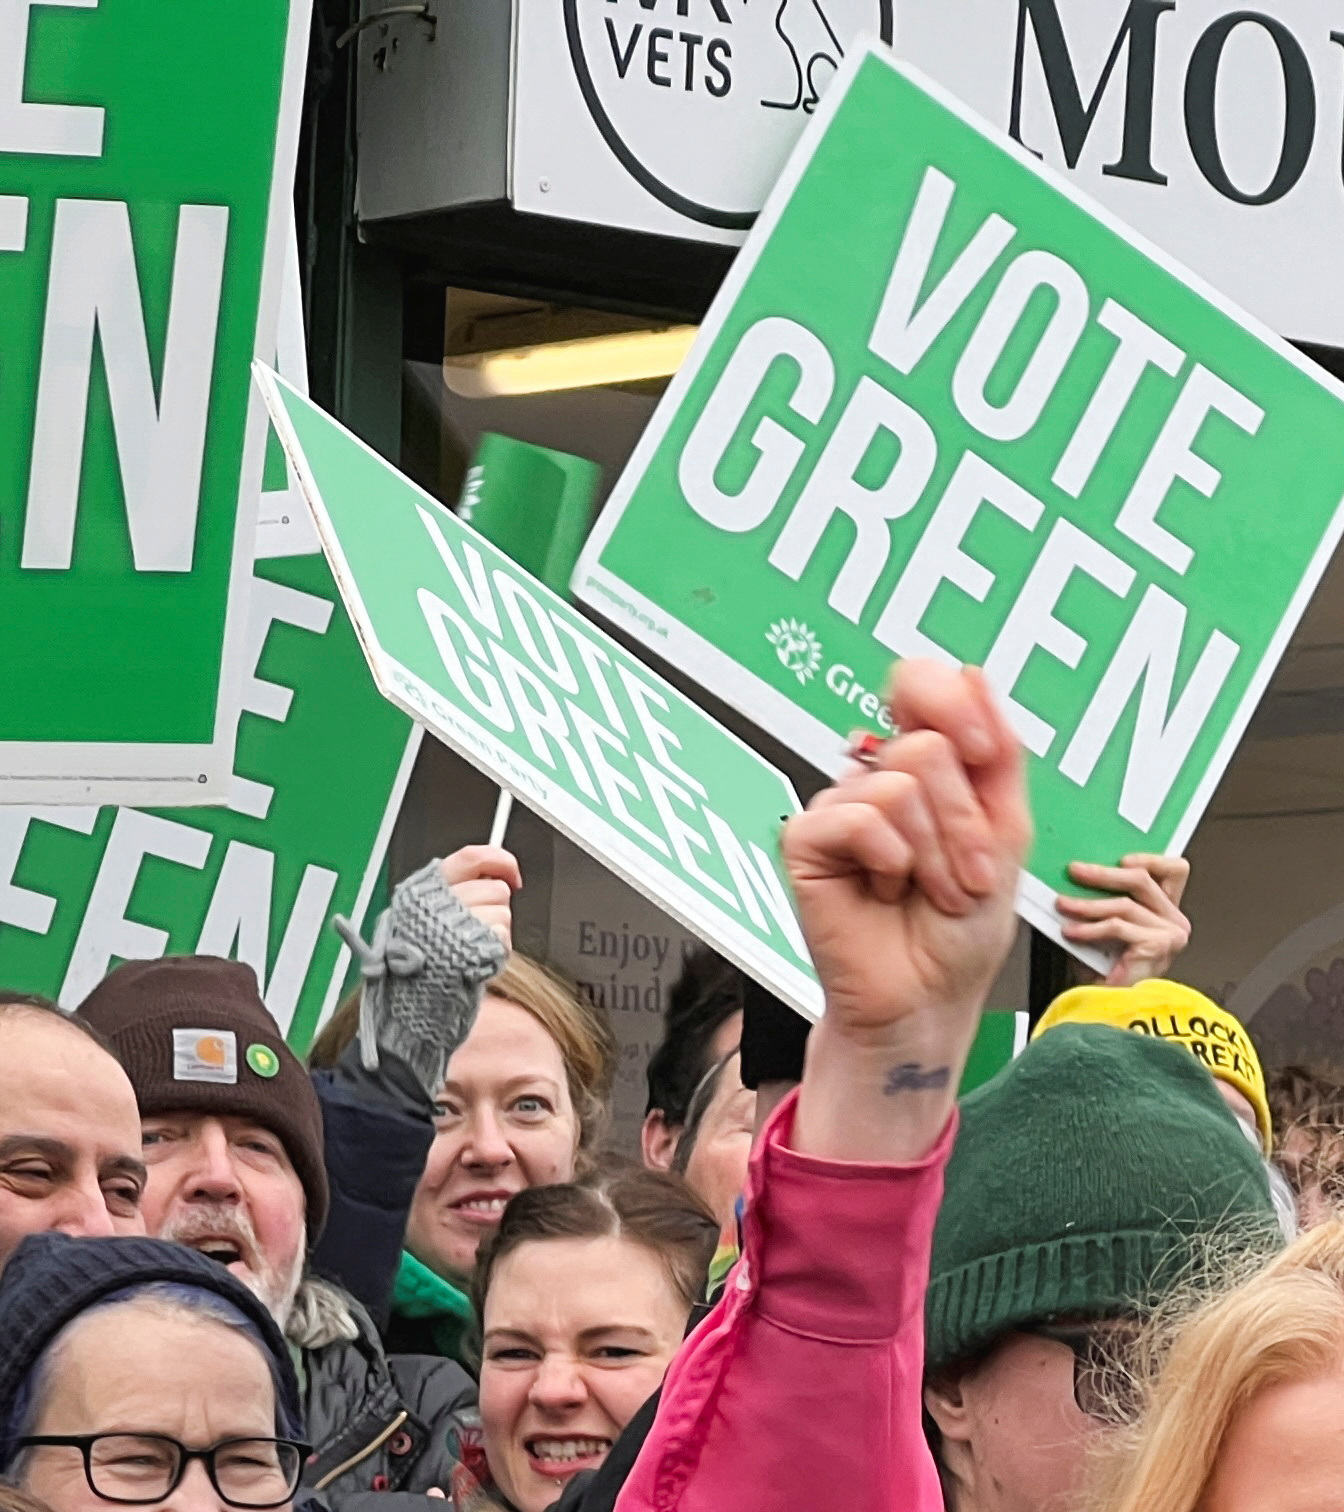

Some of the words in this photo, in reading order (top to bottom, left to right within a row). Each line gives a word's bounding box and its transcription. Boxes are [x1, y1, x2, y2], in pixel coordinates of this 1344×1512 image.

[604, 17, 733, 98] VETS
[867, 166, 1266, 578] VOTE
[414, 503, 709, 801] VOTE
[678, 316, 1241, 834] GREEN
[826, 663, 900, 735] Gree
[416, 588, 814, 967] GREEN
[577, 920, 670, 972] Enjoy
